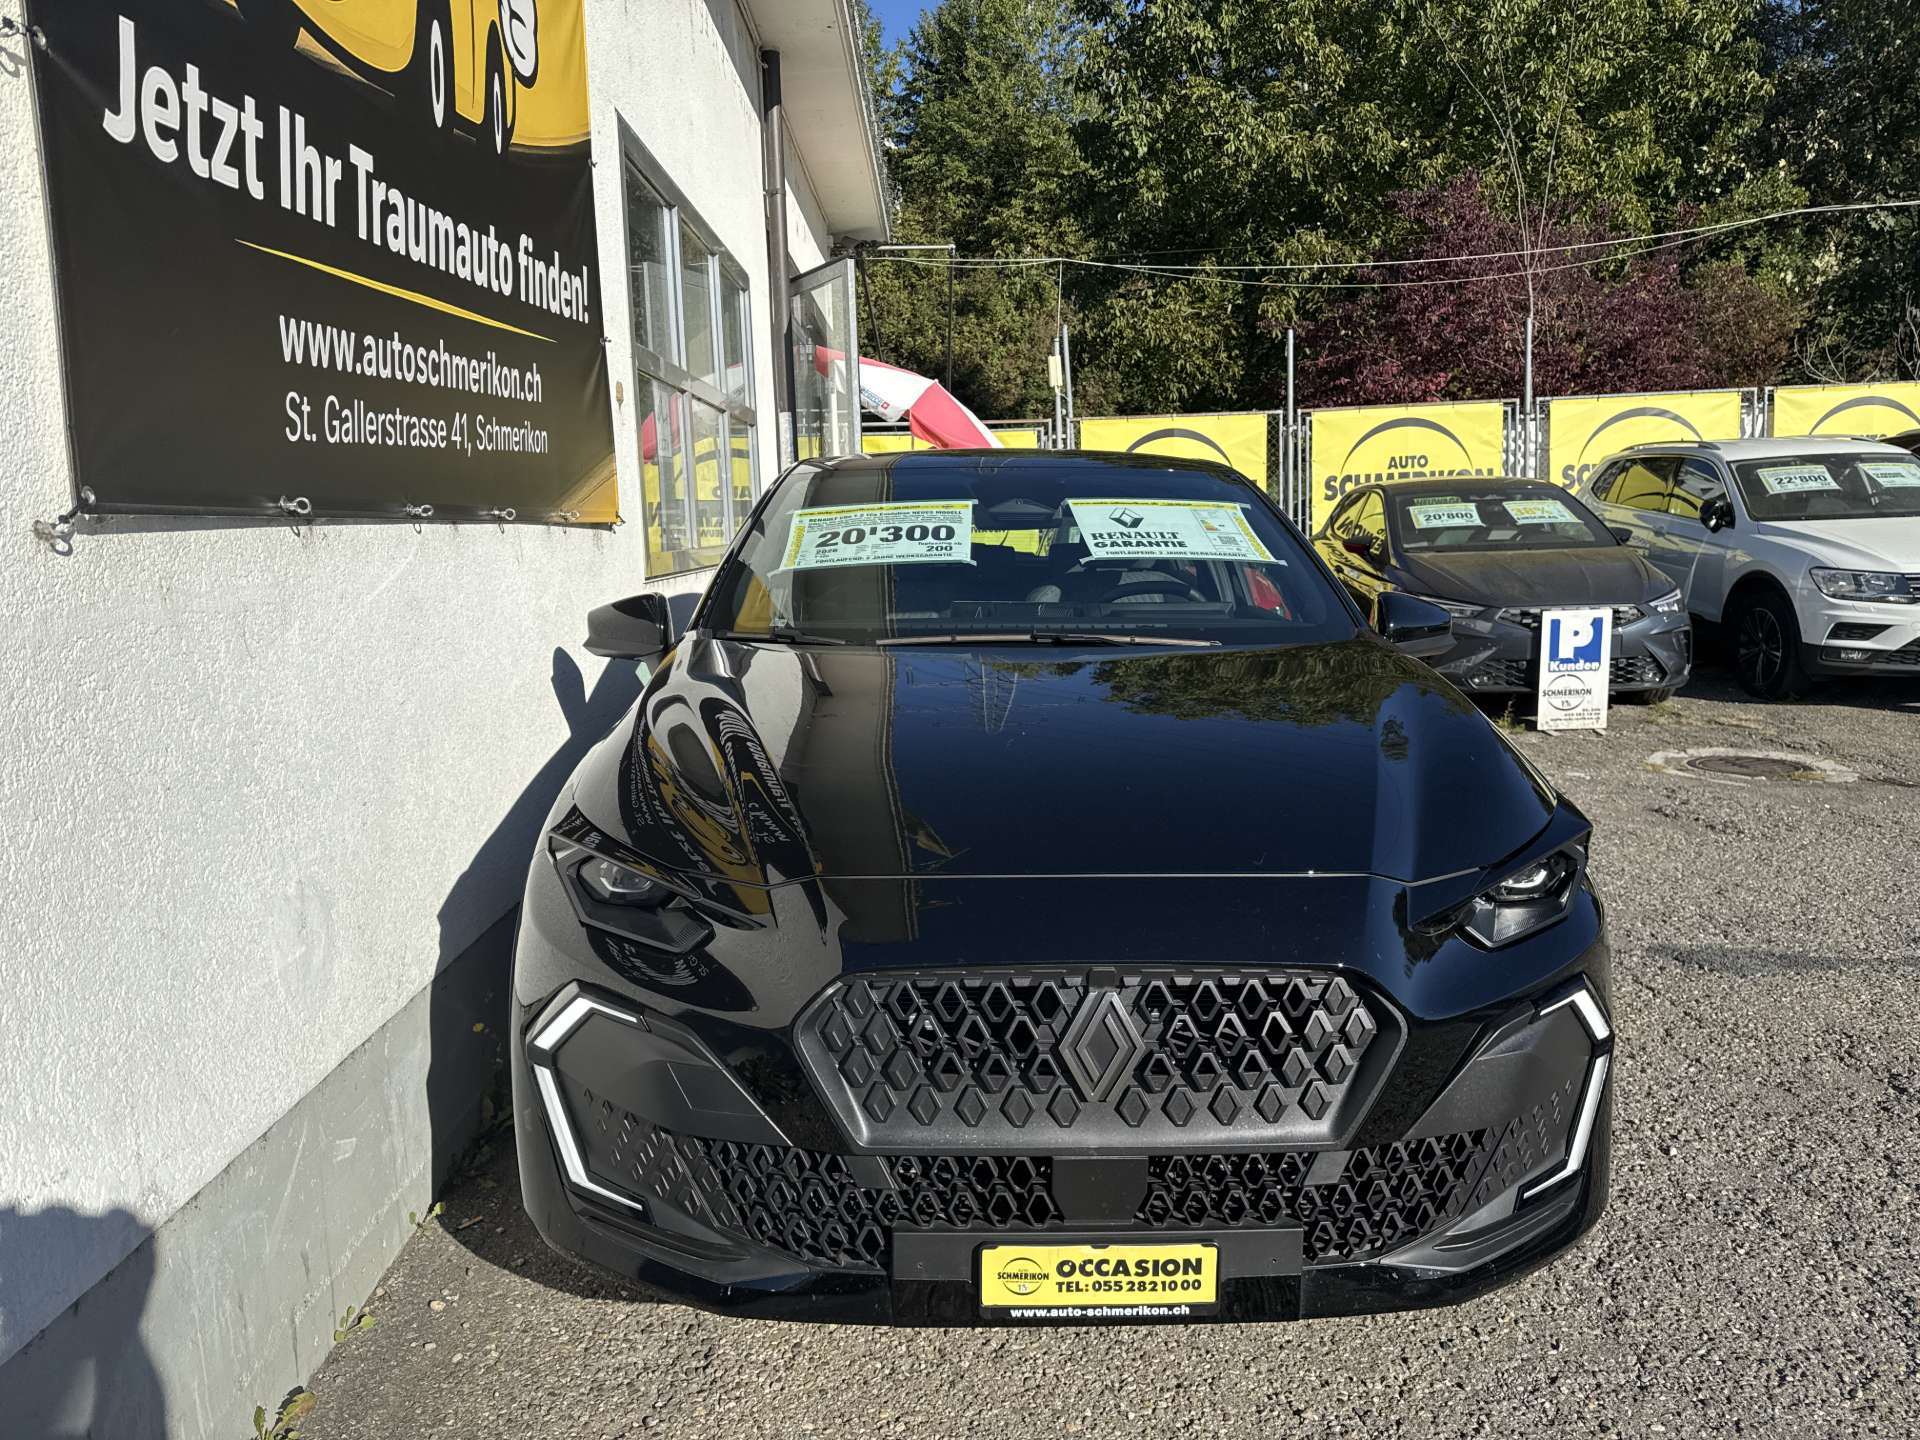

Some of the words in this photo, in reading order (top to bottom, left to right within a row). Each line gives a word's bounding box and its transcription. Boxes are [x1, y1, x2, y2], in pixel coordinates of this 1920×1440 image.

[102, 14, 264, 200] Jetzt
[279, 105, 342, 228] Ihr
[349, 143, 514, 297] Traumauto
[517, 233, 589, 324] finden!
[279, 315, 542, 402] www.autoschmerikon.ch
[285, 391, 317, 442] St.
[324, 395, 447, 448] Gallerstrasse
[451, 412, 471, 456] 41,
[476, 414, 548, 453] Schmerikon
[1387, 455, 1428, 470] AUTO
[815, 525, 955, 548] 20'300
[1090, 531, 1180, 540] RENAULT
[1093, 540, 1188, 548] GARANTIE
[1549, 659, 1601, 672] Kunden
[1056, 1258, 1202, 1277] OCCASION
[997, 1272, 1049, 1280] SCHMERIKON
[1056, 1281, 1089, 1292] TEL:
[1092, 1280, 1123, 1292] 055
[1010, 1305, 1190, 1318] www.auto-schmerikon.ch
